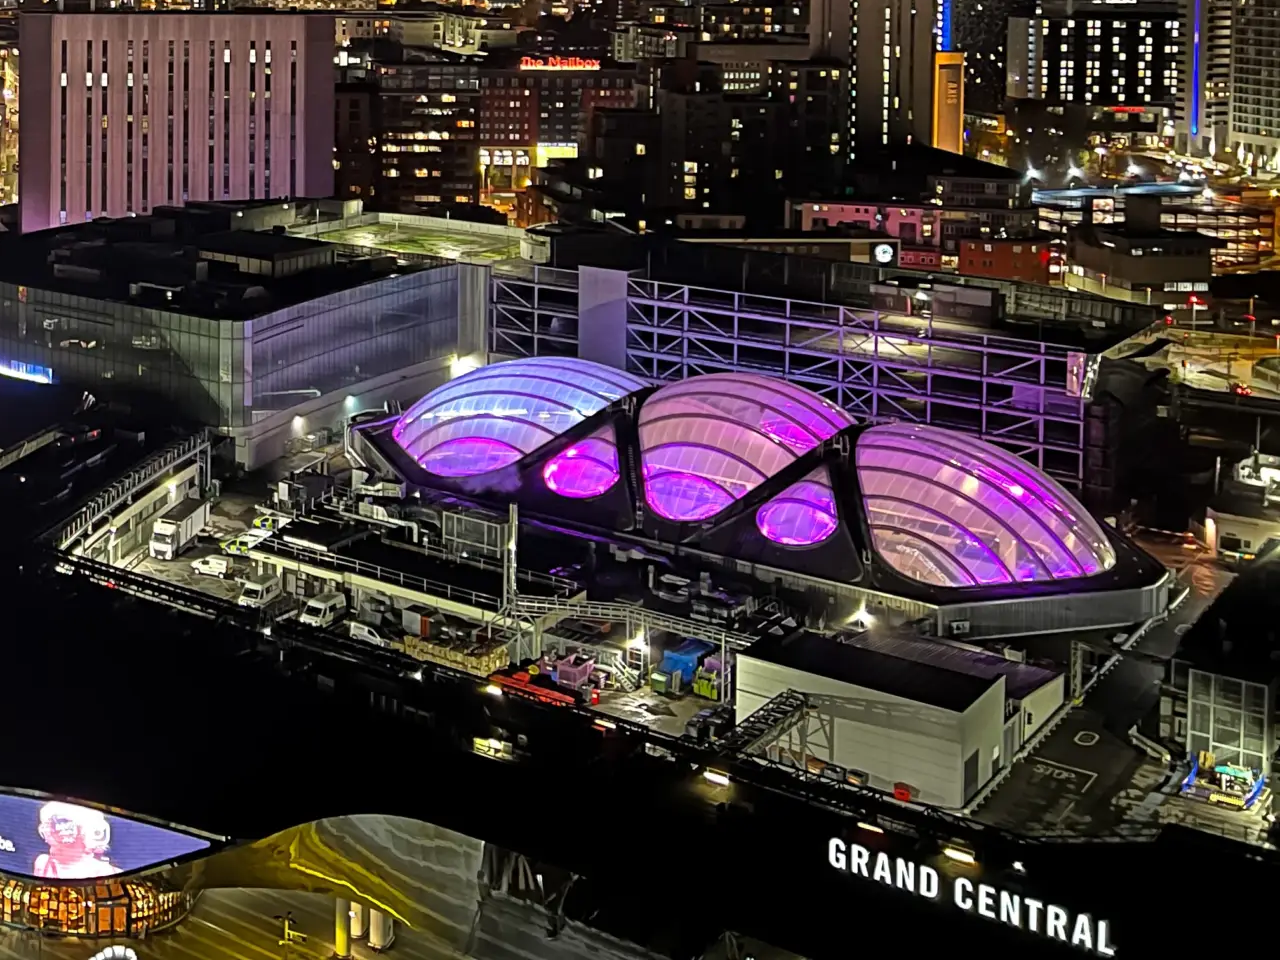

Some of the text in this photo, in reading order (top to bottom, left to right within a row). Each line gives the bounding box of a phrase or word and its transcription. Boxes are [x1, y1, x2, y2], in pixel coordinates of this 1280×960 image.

[520, 55, 601, 69] The Mailbox
[947, 81, 958, 105] AXIS
[1033, 763, 1077, 782] STOP
[828, 837, 1117, 957] GRAND CENTRAL
